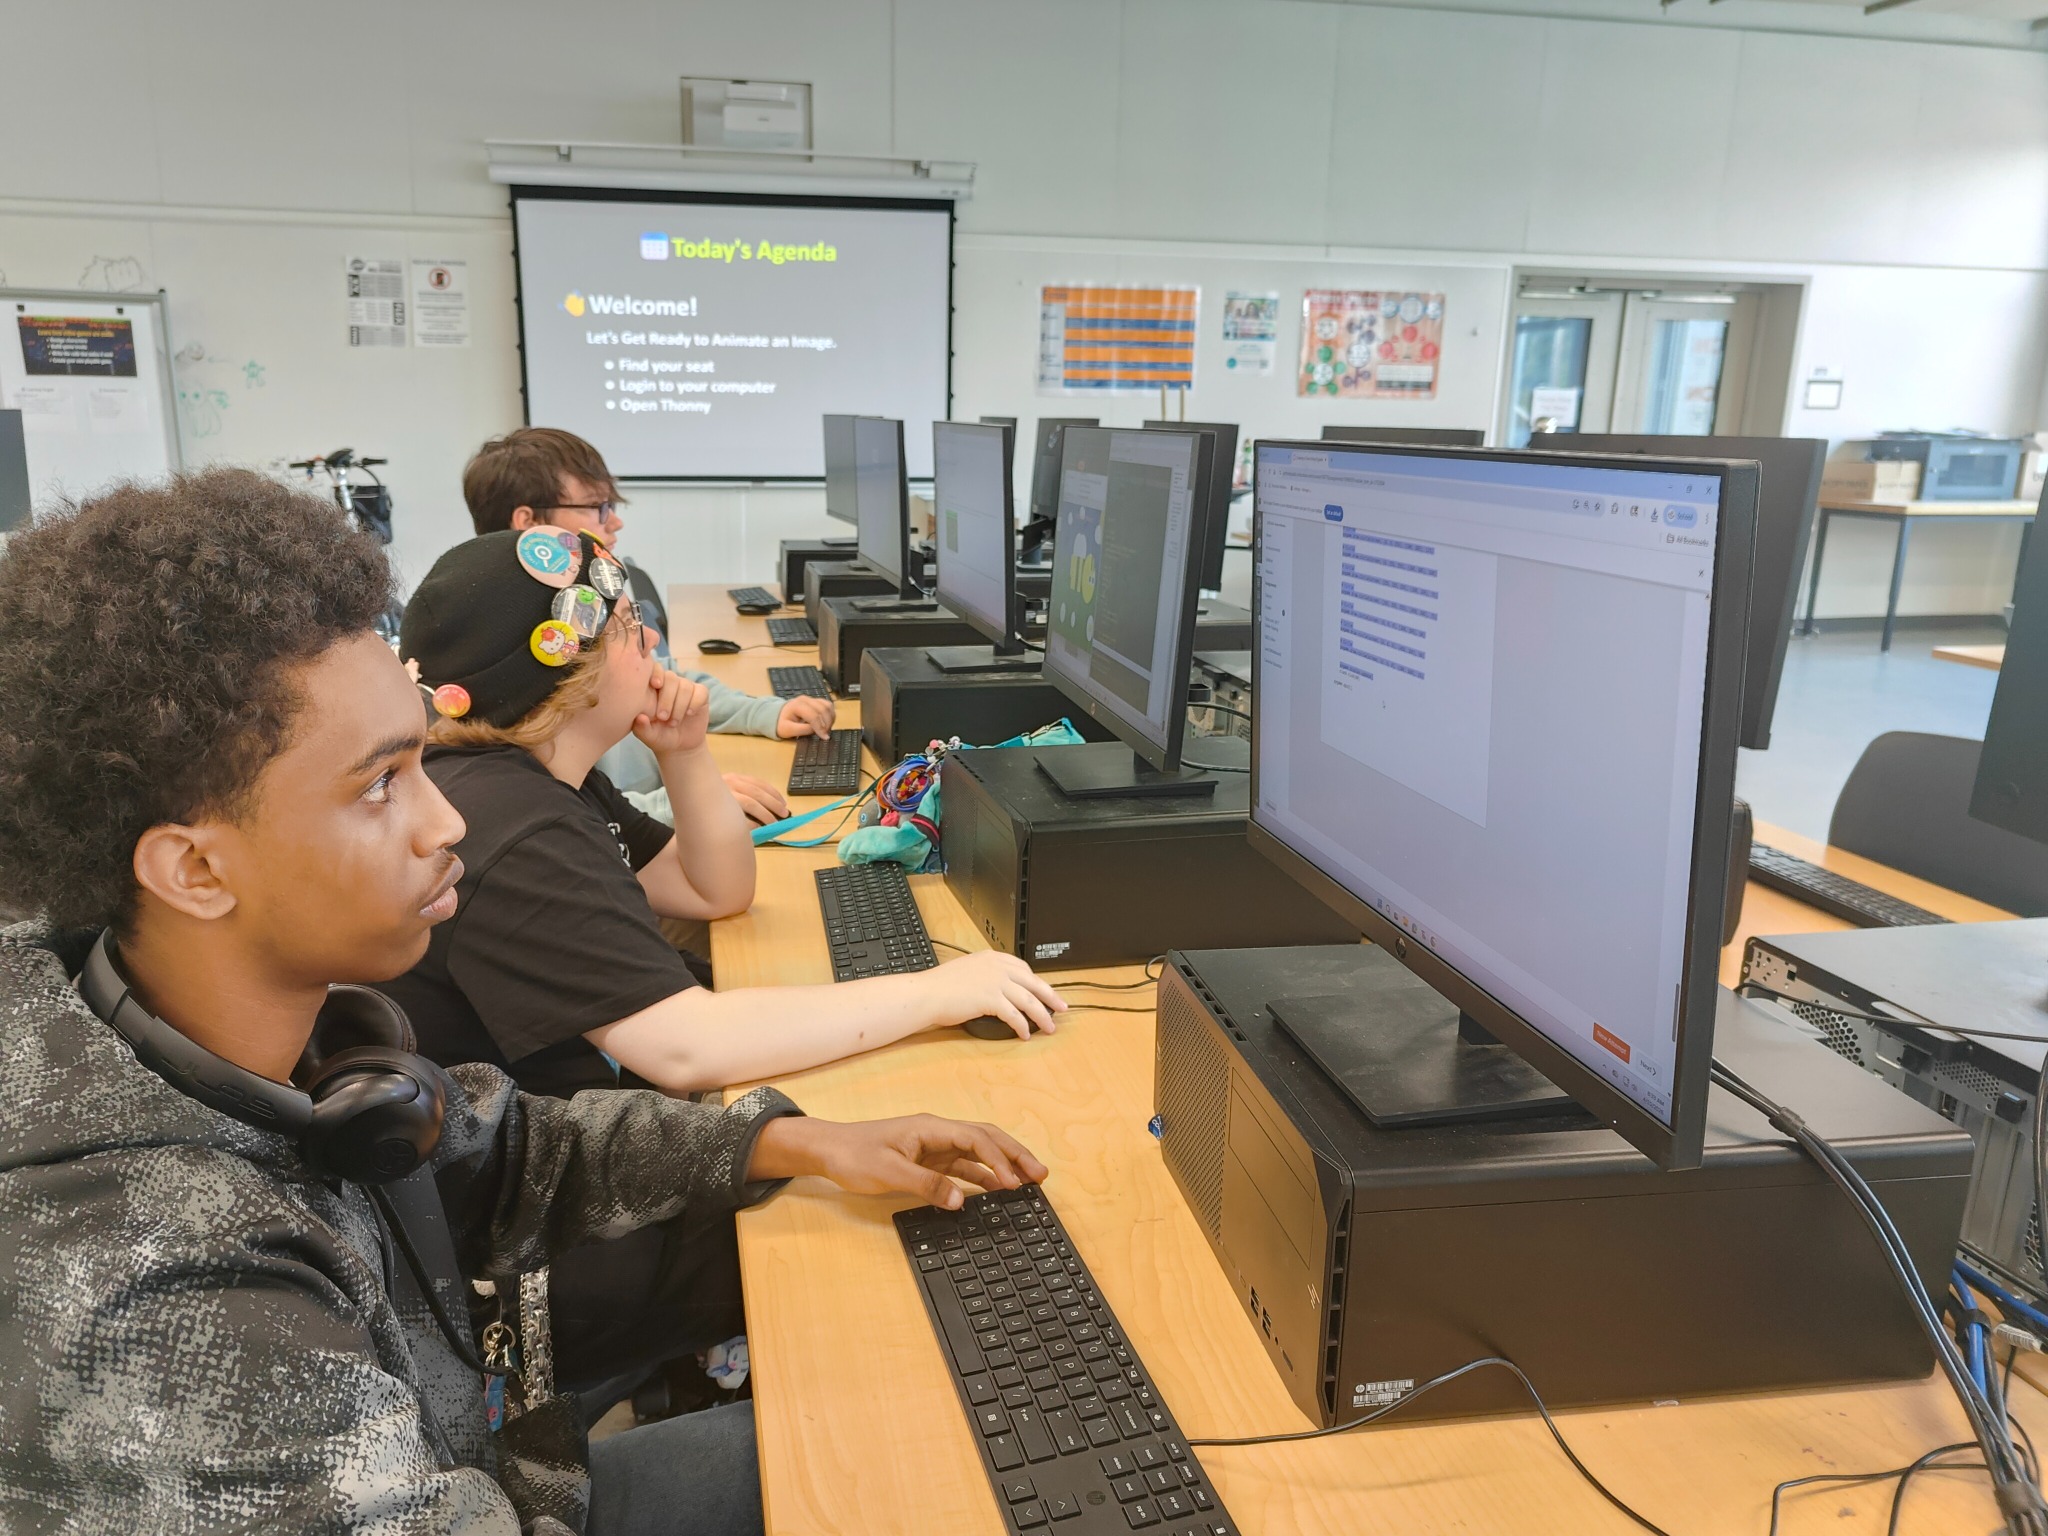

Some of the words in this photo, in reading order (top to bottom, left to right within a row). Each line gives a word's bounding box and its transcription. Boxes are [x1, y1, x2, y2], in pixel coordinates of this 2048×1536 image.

[672, 237, 752, 263] Today's
[757, 241, 837, 264] Agenda
[588, 294, 698, 317] Welcome!
[586, 331, 619, 345] Let's
[622, 332, 646, 346] Get
[649, 332, 692, 348] Ready
[694, 335, 709, 347] to
[712, 334, 769, 348] Animate
[771, 338, 789, 349] an
[792, 336, 838, 351] Image.
[618, 360, 648, 372] Find
[651, 362, 684, 375] your
[686, 361, 715, 373] seat
[619, 380, 656, 395] Login
[659, 381, 674, 393] to
[676, 382, 708, 396] your
[710, 382, 776, 397] computer
[620, 400, 658, 414] Open
[660, 398, 712, 415] Thonny
